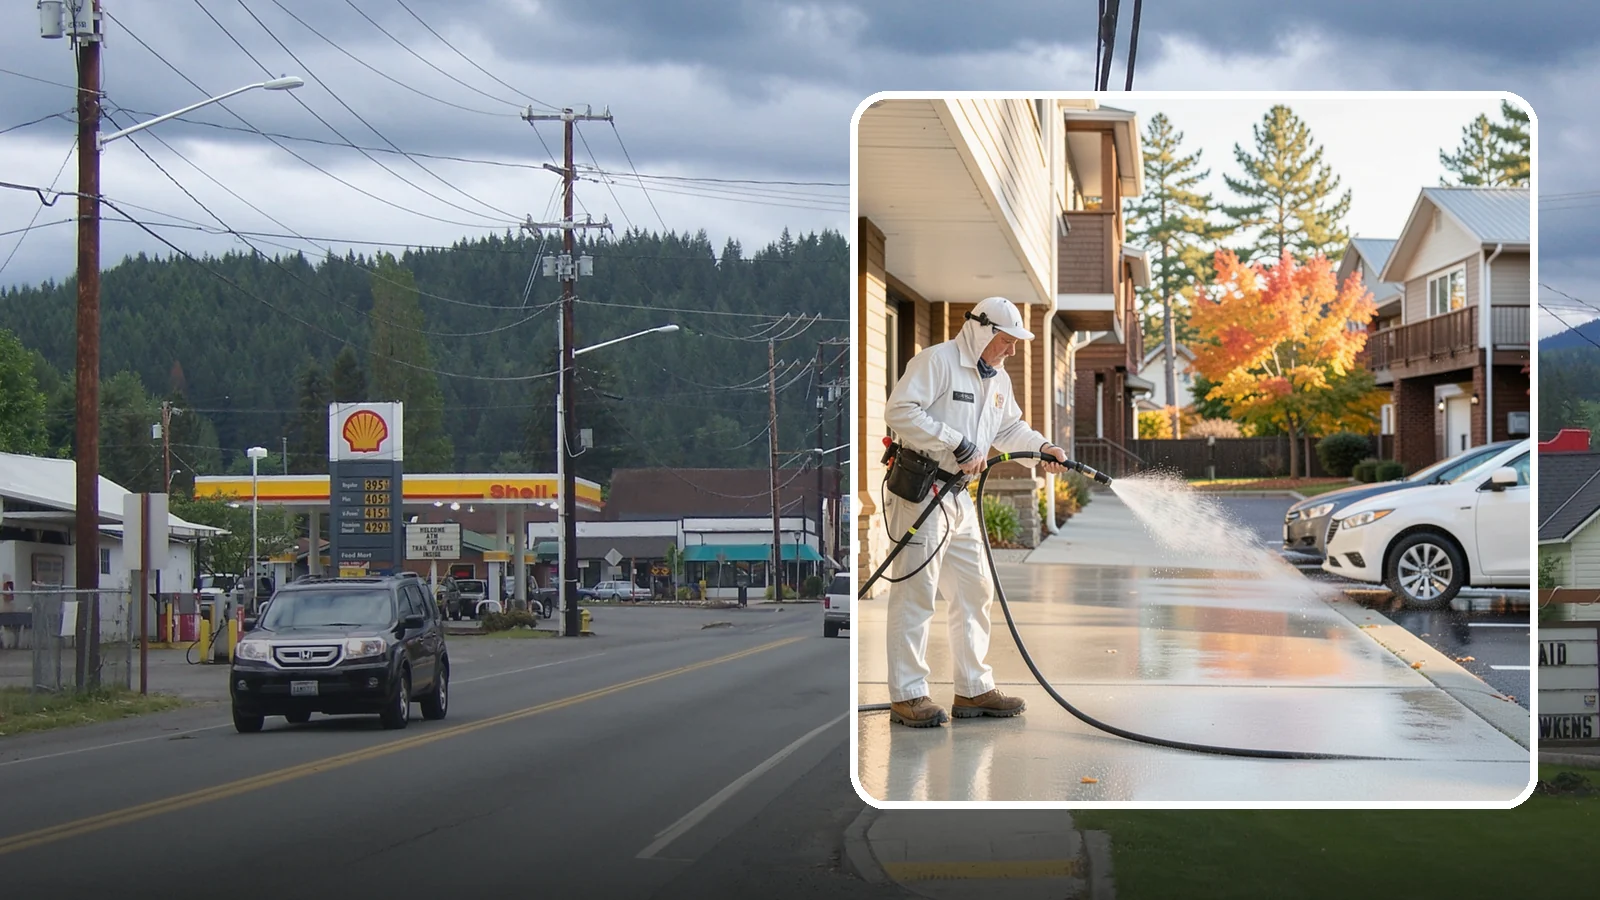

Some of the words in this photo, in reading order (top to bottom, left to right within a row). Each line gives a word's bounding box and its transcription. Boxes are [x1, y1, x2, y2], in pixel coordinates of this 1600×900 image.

[366, 480, 383, 490] 395
[490, 484, 547, 498] Shell
[366, 494, 383, 504] 405
[366, 508, 383, 518] 415
[366, 522, 383, 532] 429
[1539, 716, 1592, 739] WKENS
